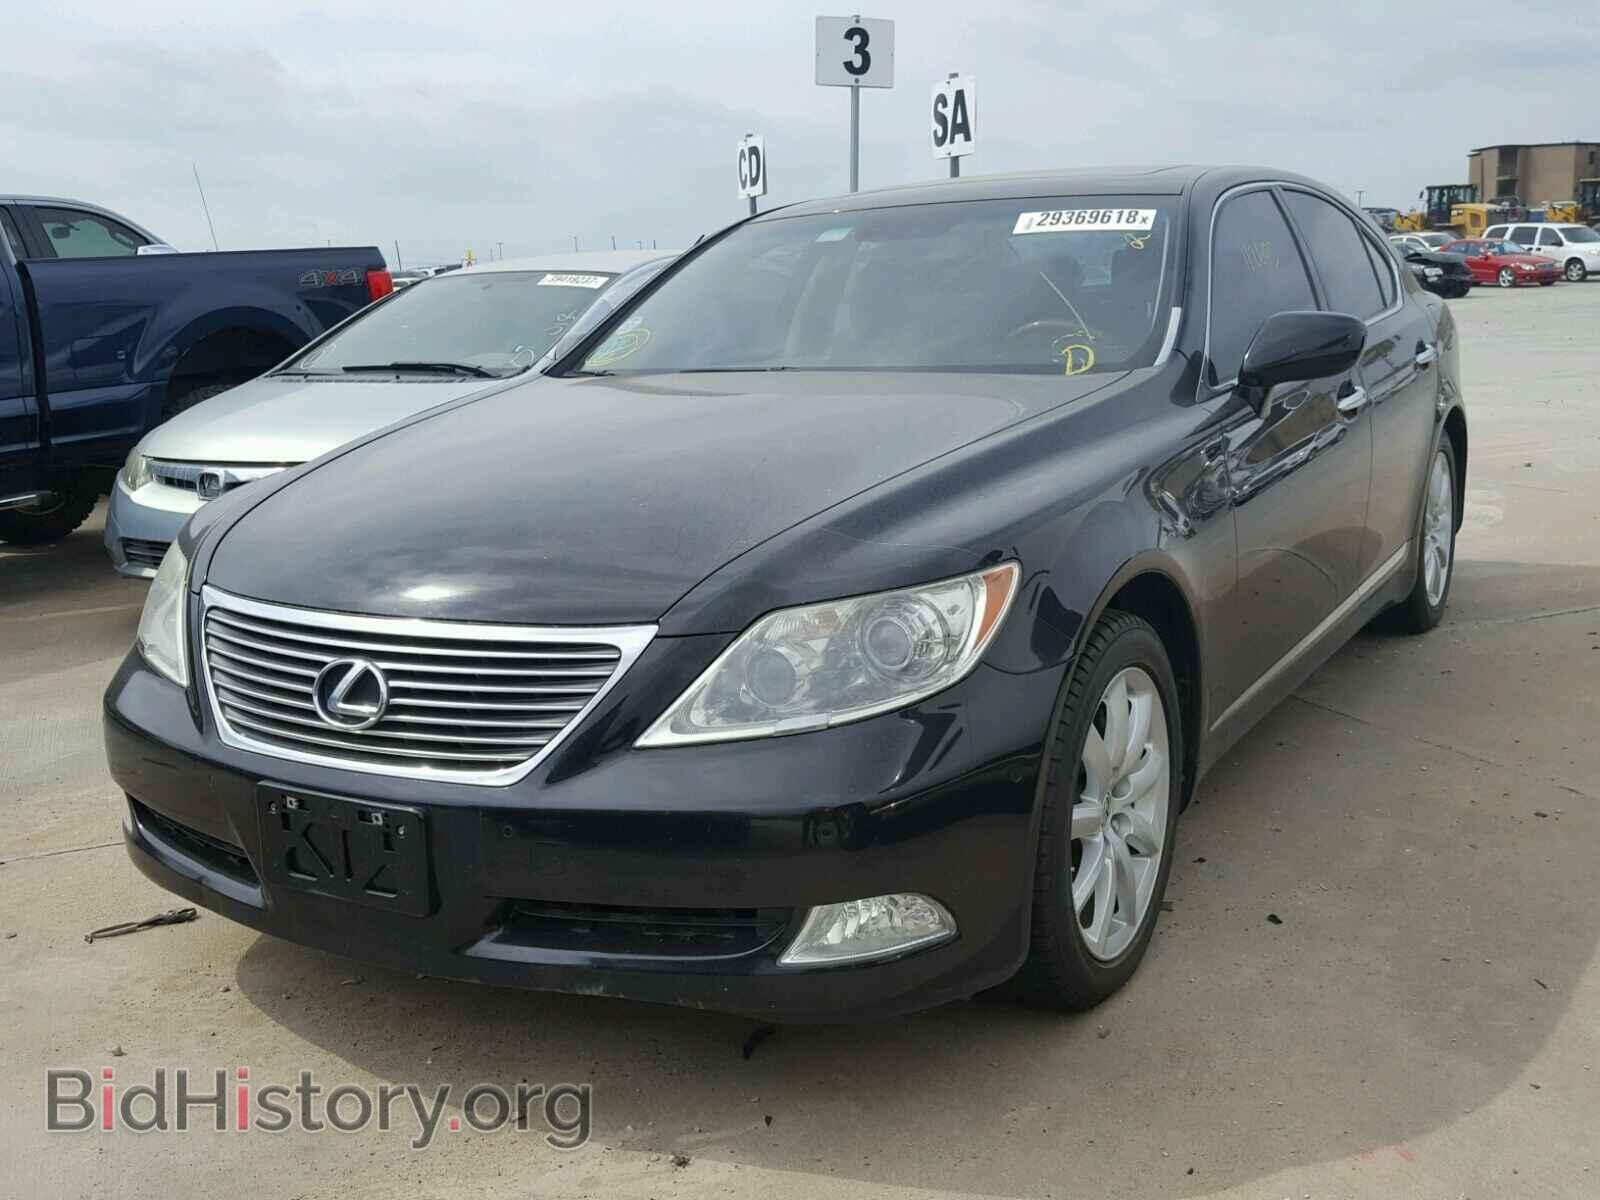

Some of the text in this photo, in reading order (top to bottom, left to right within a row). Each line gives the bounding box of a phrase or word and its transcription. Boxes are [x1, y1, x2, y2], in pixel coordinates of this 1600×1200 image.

[842, 27, 871, 75] 3
[932, 88, 972, 148] SA
[738, 145, 761, 190] CD
[1036, 210, 1139, 227] 29369618
